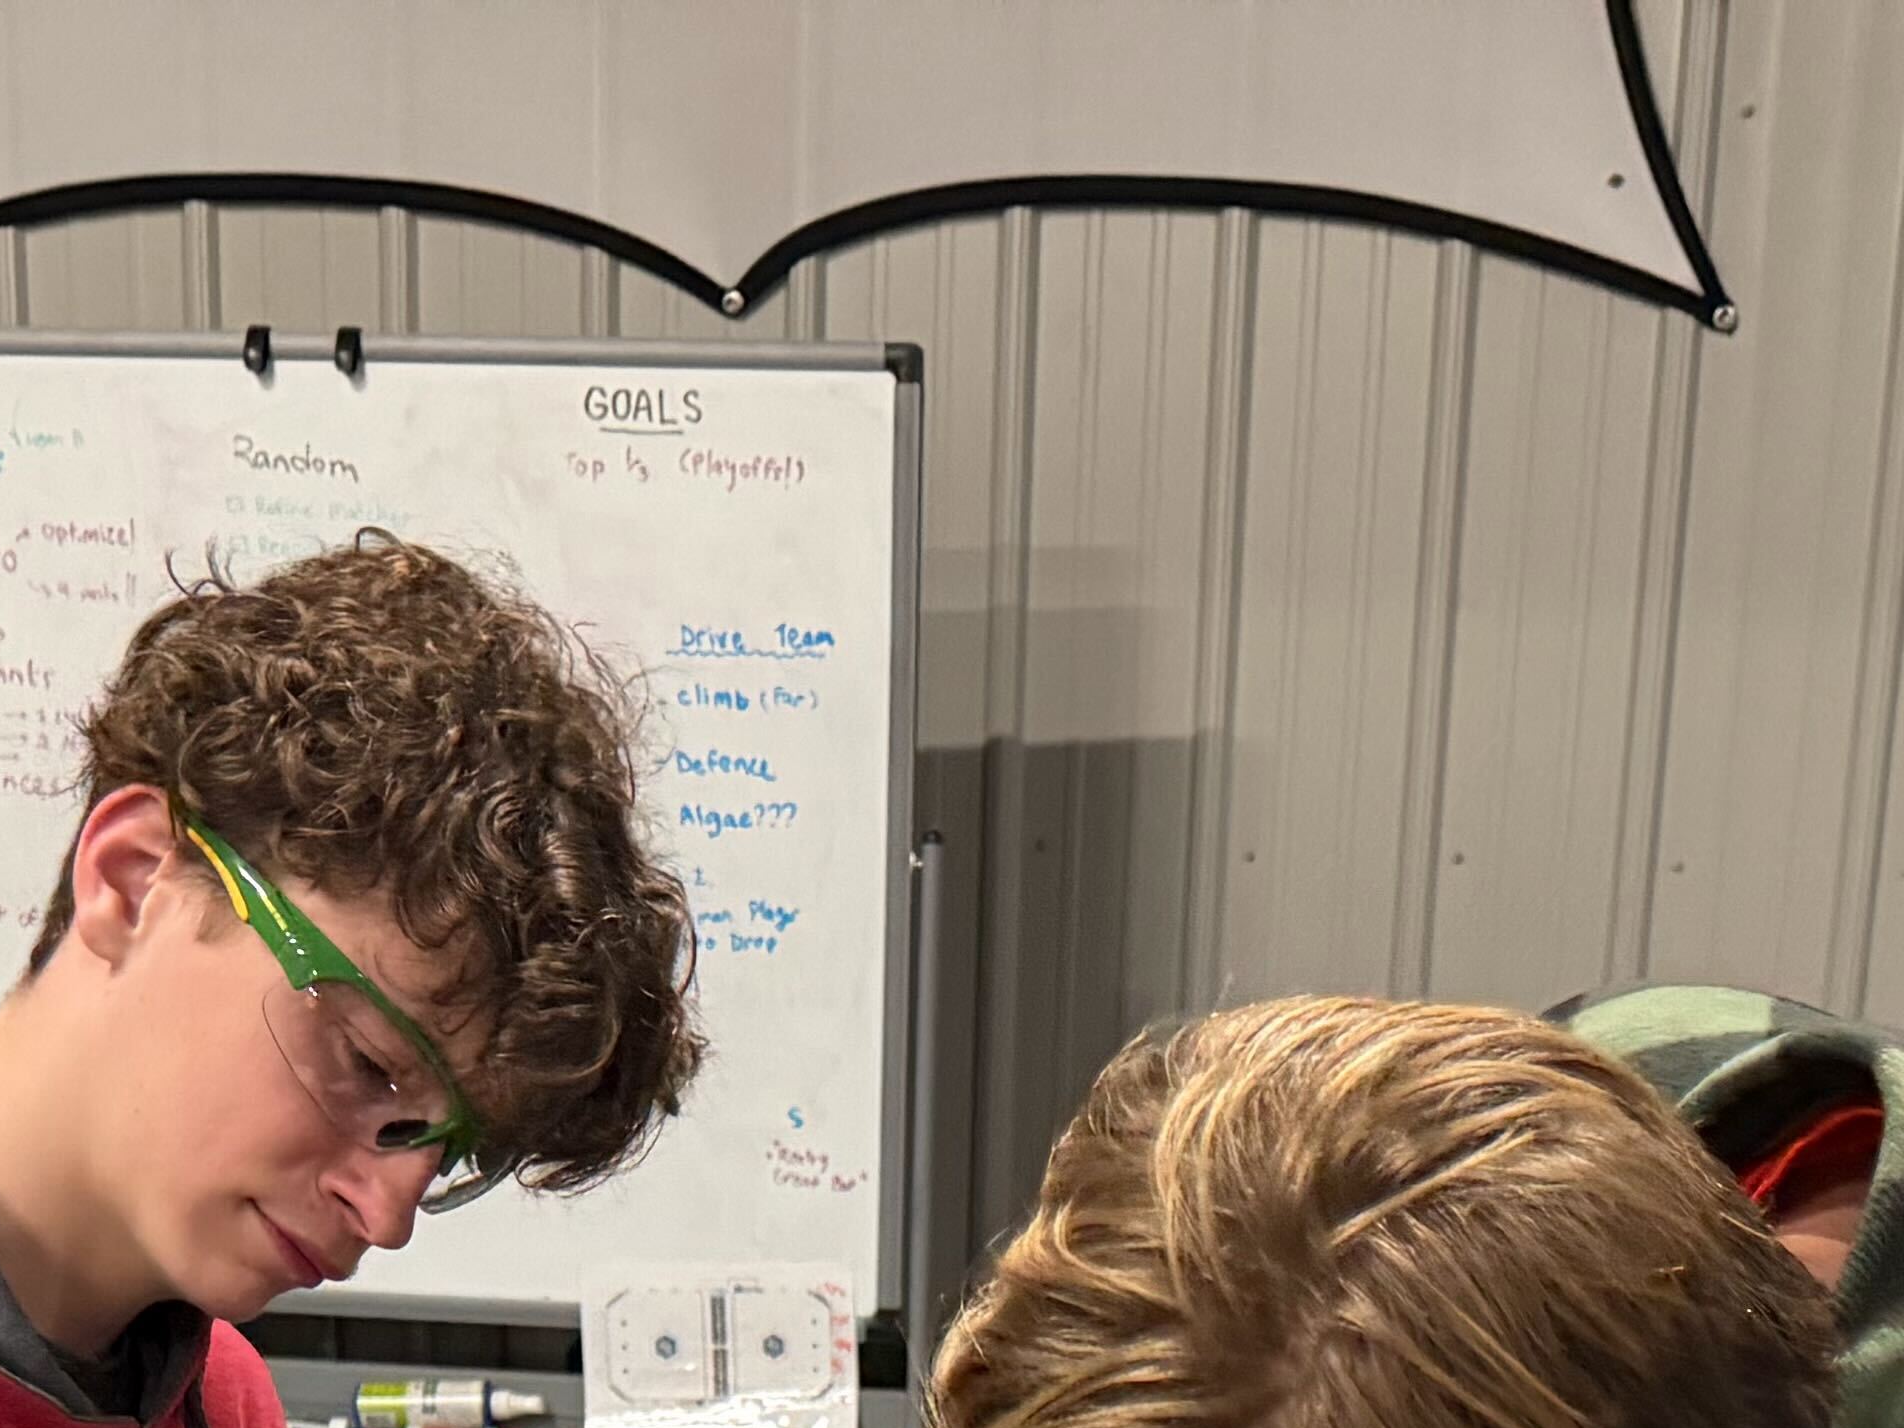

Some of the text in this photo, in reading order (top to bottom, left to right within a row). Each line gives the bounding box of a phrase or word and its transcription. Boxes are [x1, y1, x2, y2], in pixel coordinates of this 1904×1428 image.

[584, 385, 703, 425] GOALS
[233, 434, 359, 484] Random
[681, 623, 835, 651] Drive Team
[675, 749, 777, 782] Defence
